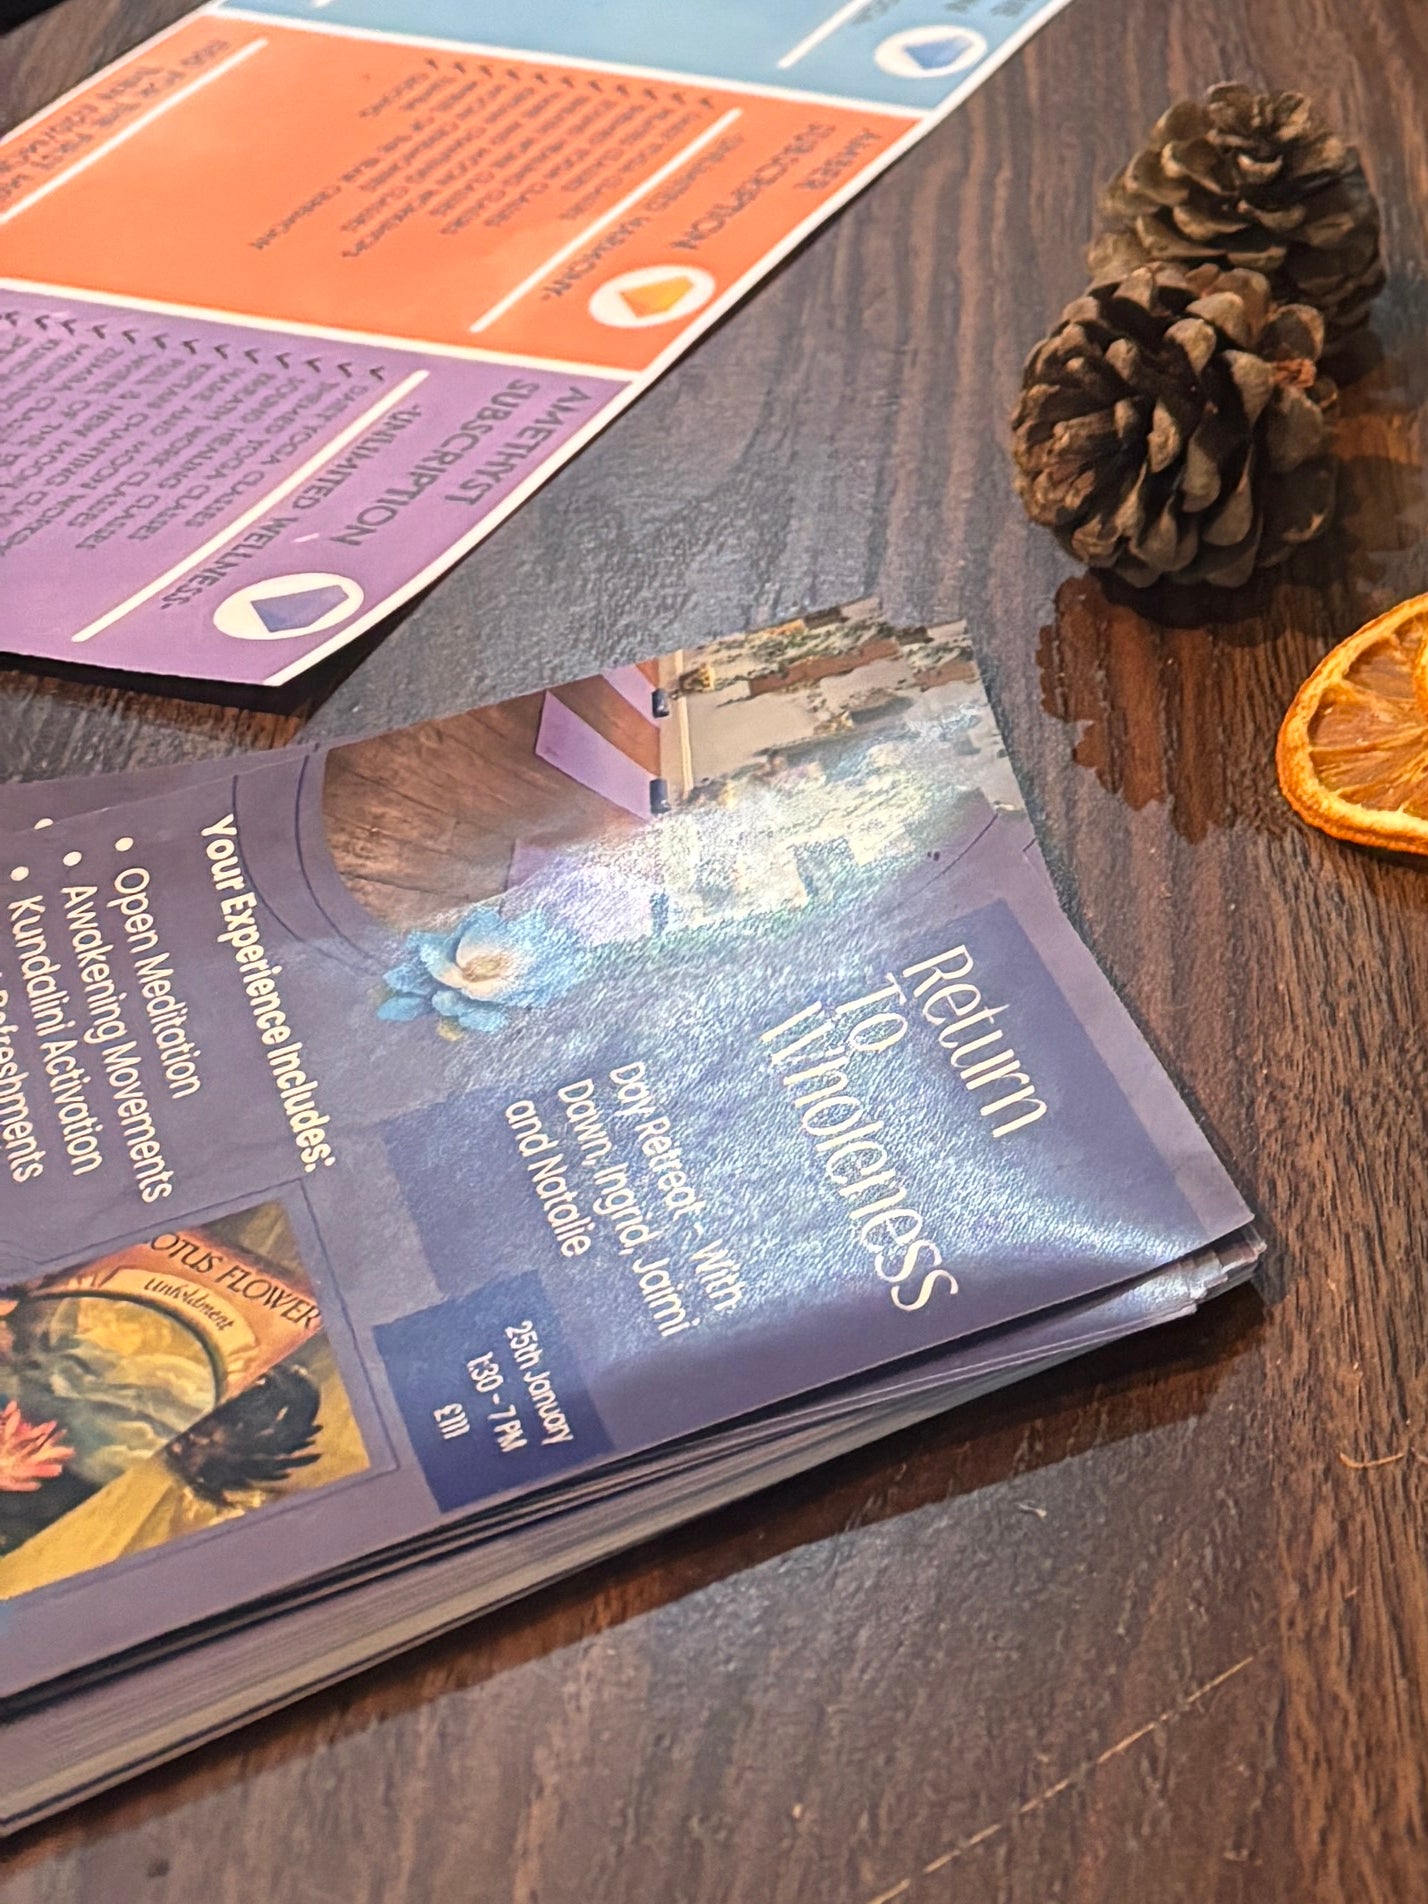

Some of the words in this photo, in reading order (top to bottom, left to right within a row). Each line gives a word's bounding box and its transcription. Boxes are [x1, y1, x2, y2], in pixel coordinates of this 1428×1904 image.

[329, 378, 540, 546] SUBSCRIPTION
[444, 385, 592, 507] AMETHYST
[201, 813, 245, 891] Your
[8, 894, 76, 1037] Kundalini
[106, 867, 159, 954] Open
[134, 951, 202, 1100] Meditation
[216, 891, 292, 1045] Experience
[40, 1039, 104, 1176] Activation
[60, 885, 128, 1044] Awakening
[102, 1040, 174, 1204] Movements
[266, 1041, 336, 1174] Includes:
[902, 944, 1048, 1138] Return
[505, 1099, 558, 1157] and
[609, 1061, 651, 1118] Day
[635, 1116, 705, 1221] Retreat
[689, 1238, 748, 1312] With
[760, 1001, 959, 1312] Wholeness
[527, 1153, 596, 1258] Natalie
[557, 1078, 613, 1167] Dawn,
[593, 1162, 665, 1256] Ingrid,
[631, 1257, 700, 1338] Jaimi
[150, 1232, 223, 1273] OTUS
[216, 1264, 322, 1329] FLOWER
[432, 1402, 471, 1441] £111
[487, 1406, 515, 1421] 7
[495, 1419, 528, 1454] PM
[505, 1320, 542, 1371] 25th
[524, 1370, 573, 1446] January
